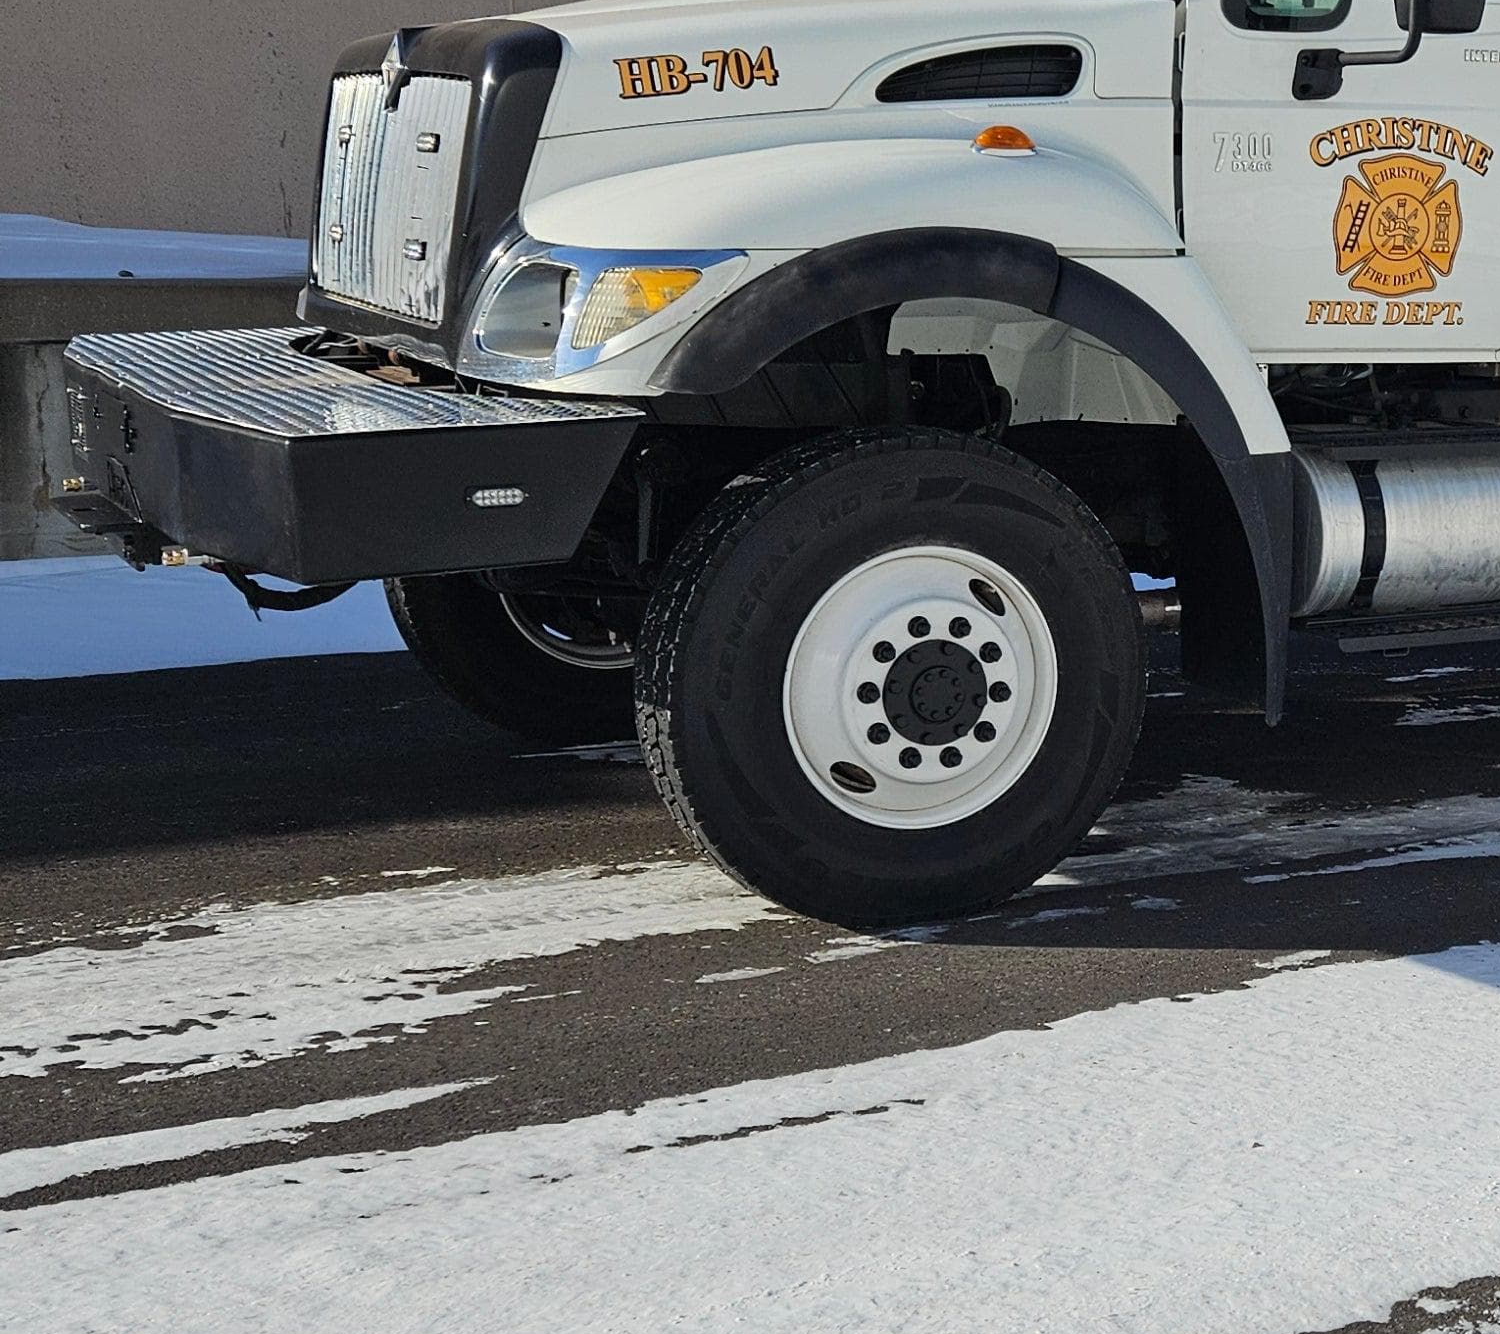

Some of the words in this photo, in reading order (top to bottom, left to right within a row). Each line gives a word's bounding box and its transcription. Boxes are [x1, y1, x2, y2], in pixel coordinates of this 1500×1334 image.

[613, 45, 779, 99] HB-704
[1213, 131, 1273, 172] 7300
[1309, 116, 1494, 177] CHRISTINE
[1371, 167, 1435, 189] CHRISTINE
[1362, 266, 1391, 287] FIRE
[1393, 267, 1424, 287] DEPT
[1305, 300, 1379, 325] FIRE
[1382, 300, 1464, 326] DEPT.
